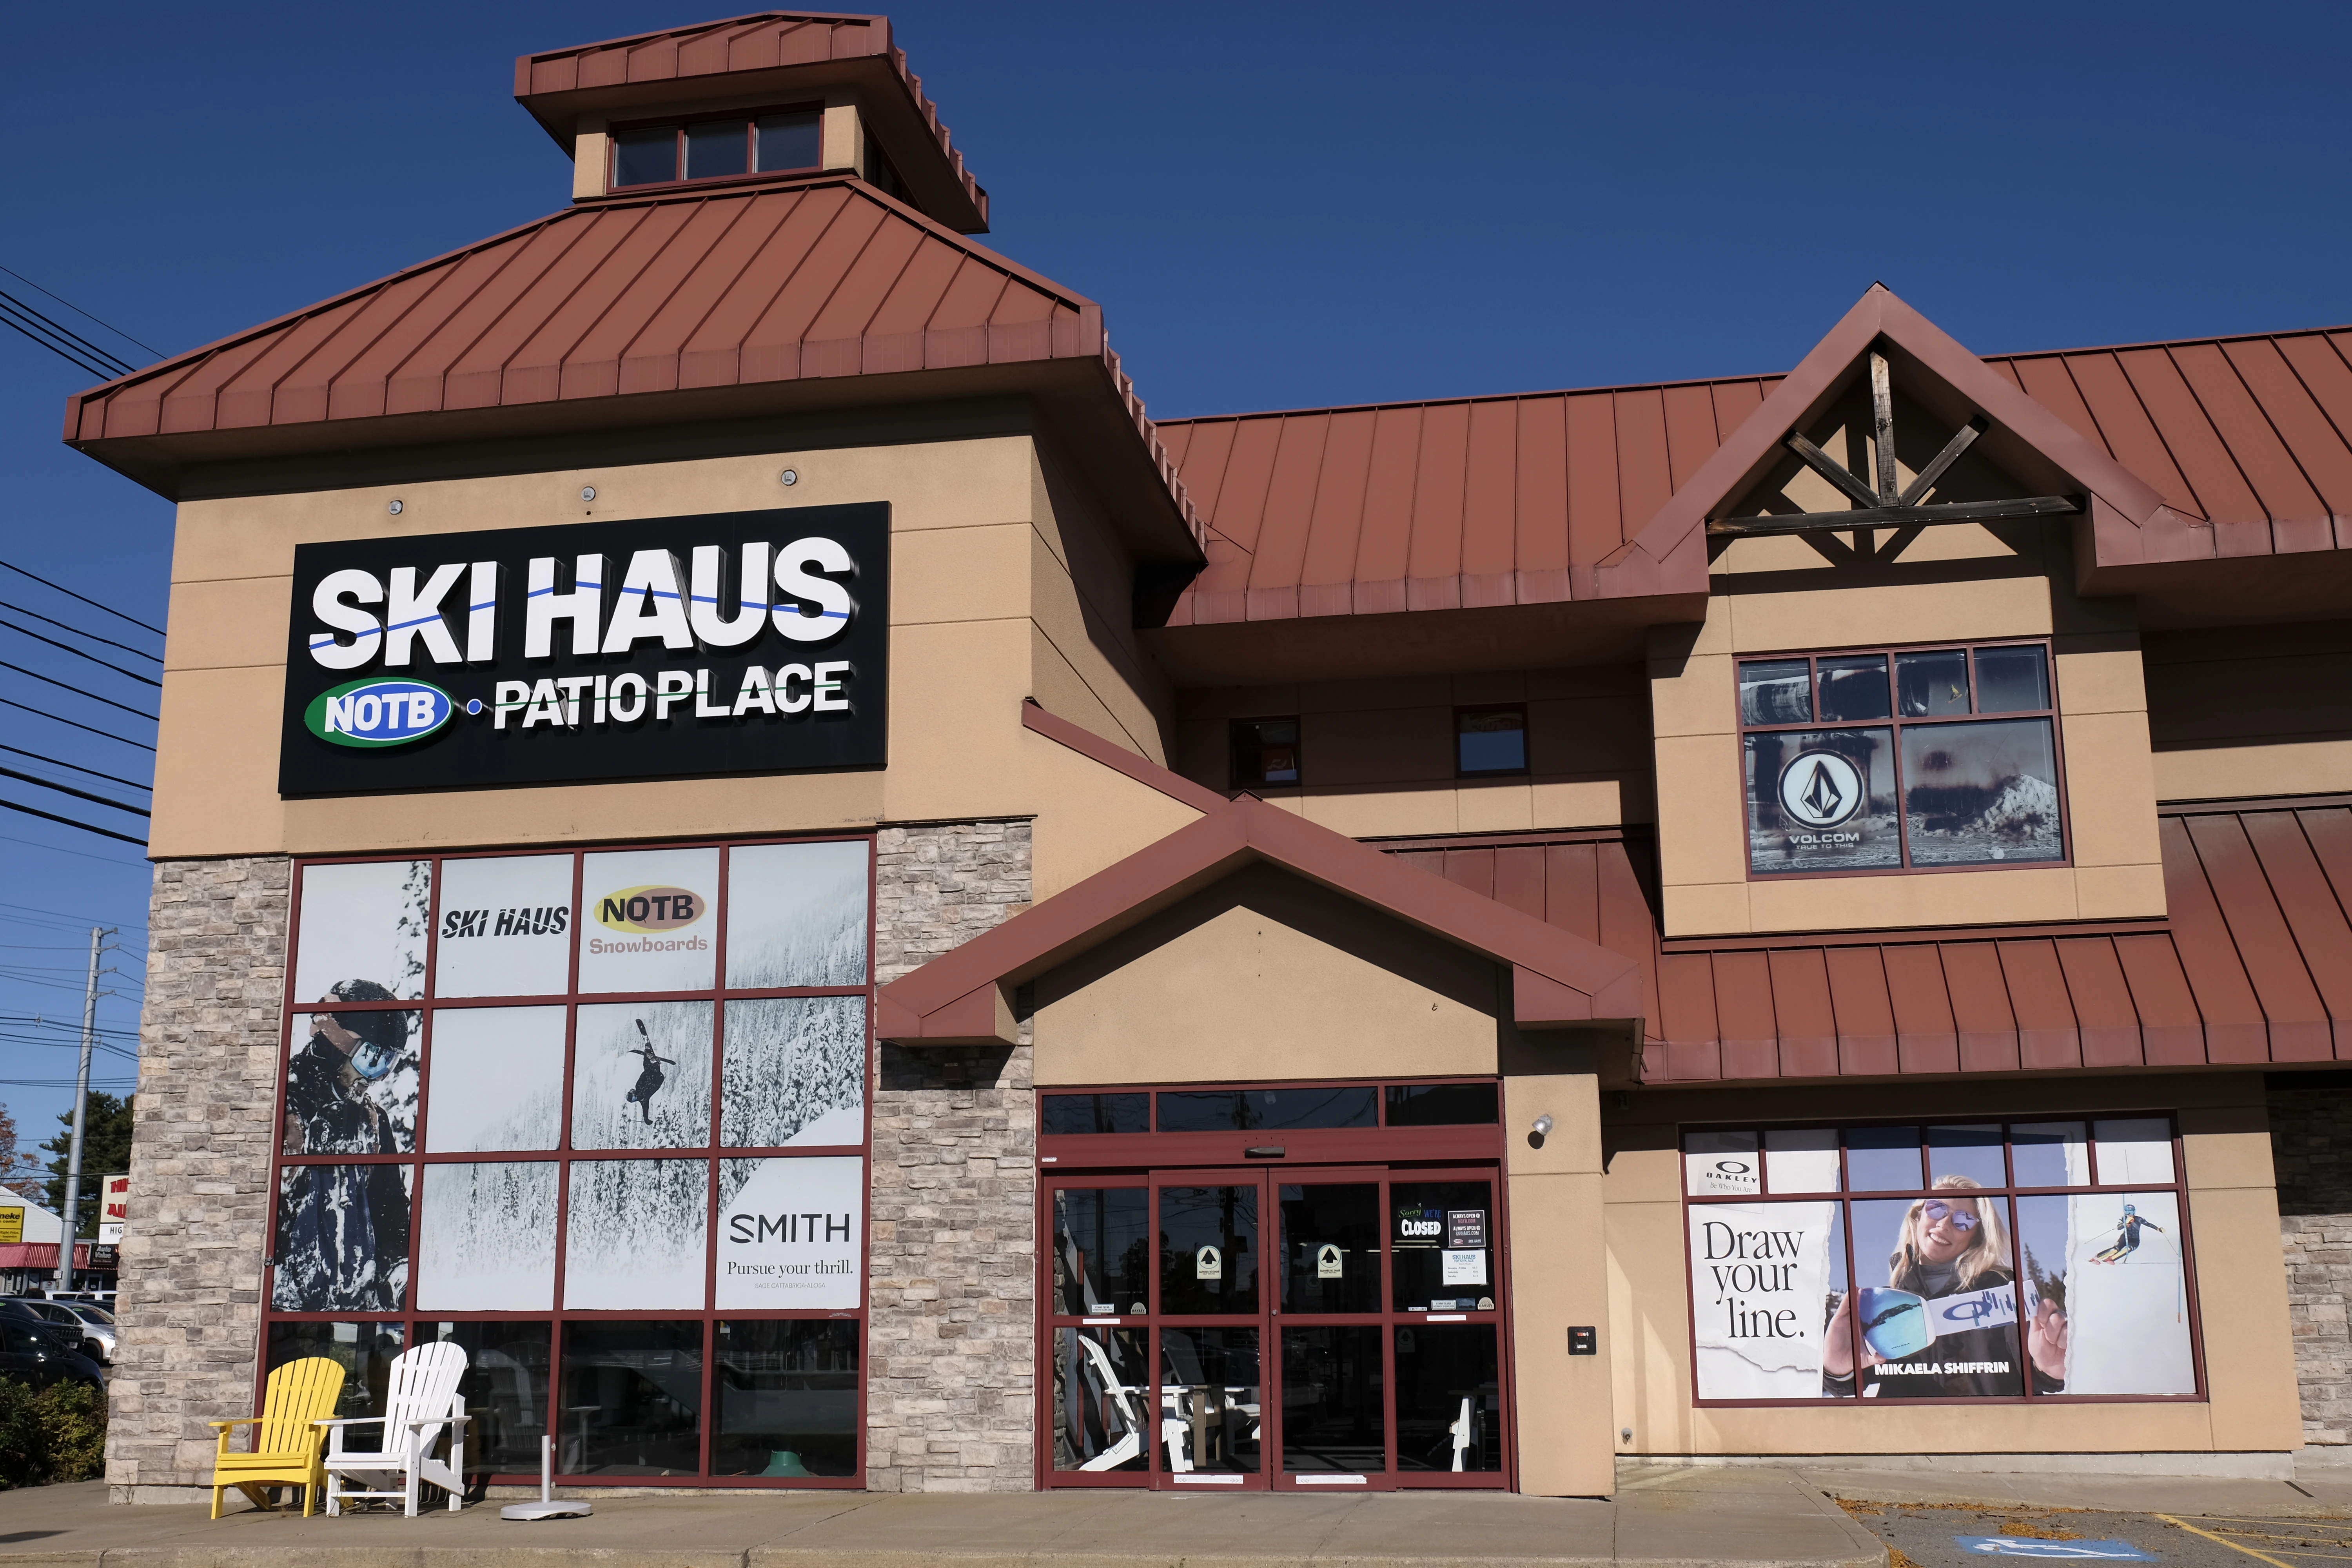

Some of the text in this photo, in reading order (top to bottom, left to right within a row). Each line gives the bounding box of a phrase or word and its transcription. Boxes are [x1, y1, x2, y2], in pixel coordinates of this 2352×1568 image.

[309, 537, 851, 670] SKI HAUS
[325, 661, 849, 733] NOTB PATIO PLACE
[1789, 833, 1859, 844] VOLCOM
[602, 894, 694, 923] NOTB
[442, 906, 569, 938] SKI HAUS
[589, 935, 708, 955] Snowboards
[1706, 1172, 1757, 1183] OAKLEY
[107, 1203, 126, 1219] AU
[1399, 1209, 1441, 1220] Sorry WE'RE
[730, 1213, 850, 1244] SMITH
[1401, 1219, 1441, 1236] CLOSED
[1702, 1221, 1805, 1259] Draw
[727, 1259, 853, 1278] Pursue your thrill.
[1710, 1263, 1798, 1305] your
[1726, 1296, 1804, 1338] line.
[1874, 1361, 2009, 1376] MIKAELA SHIFFRIN
